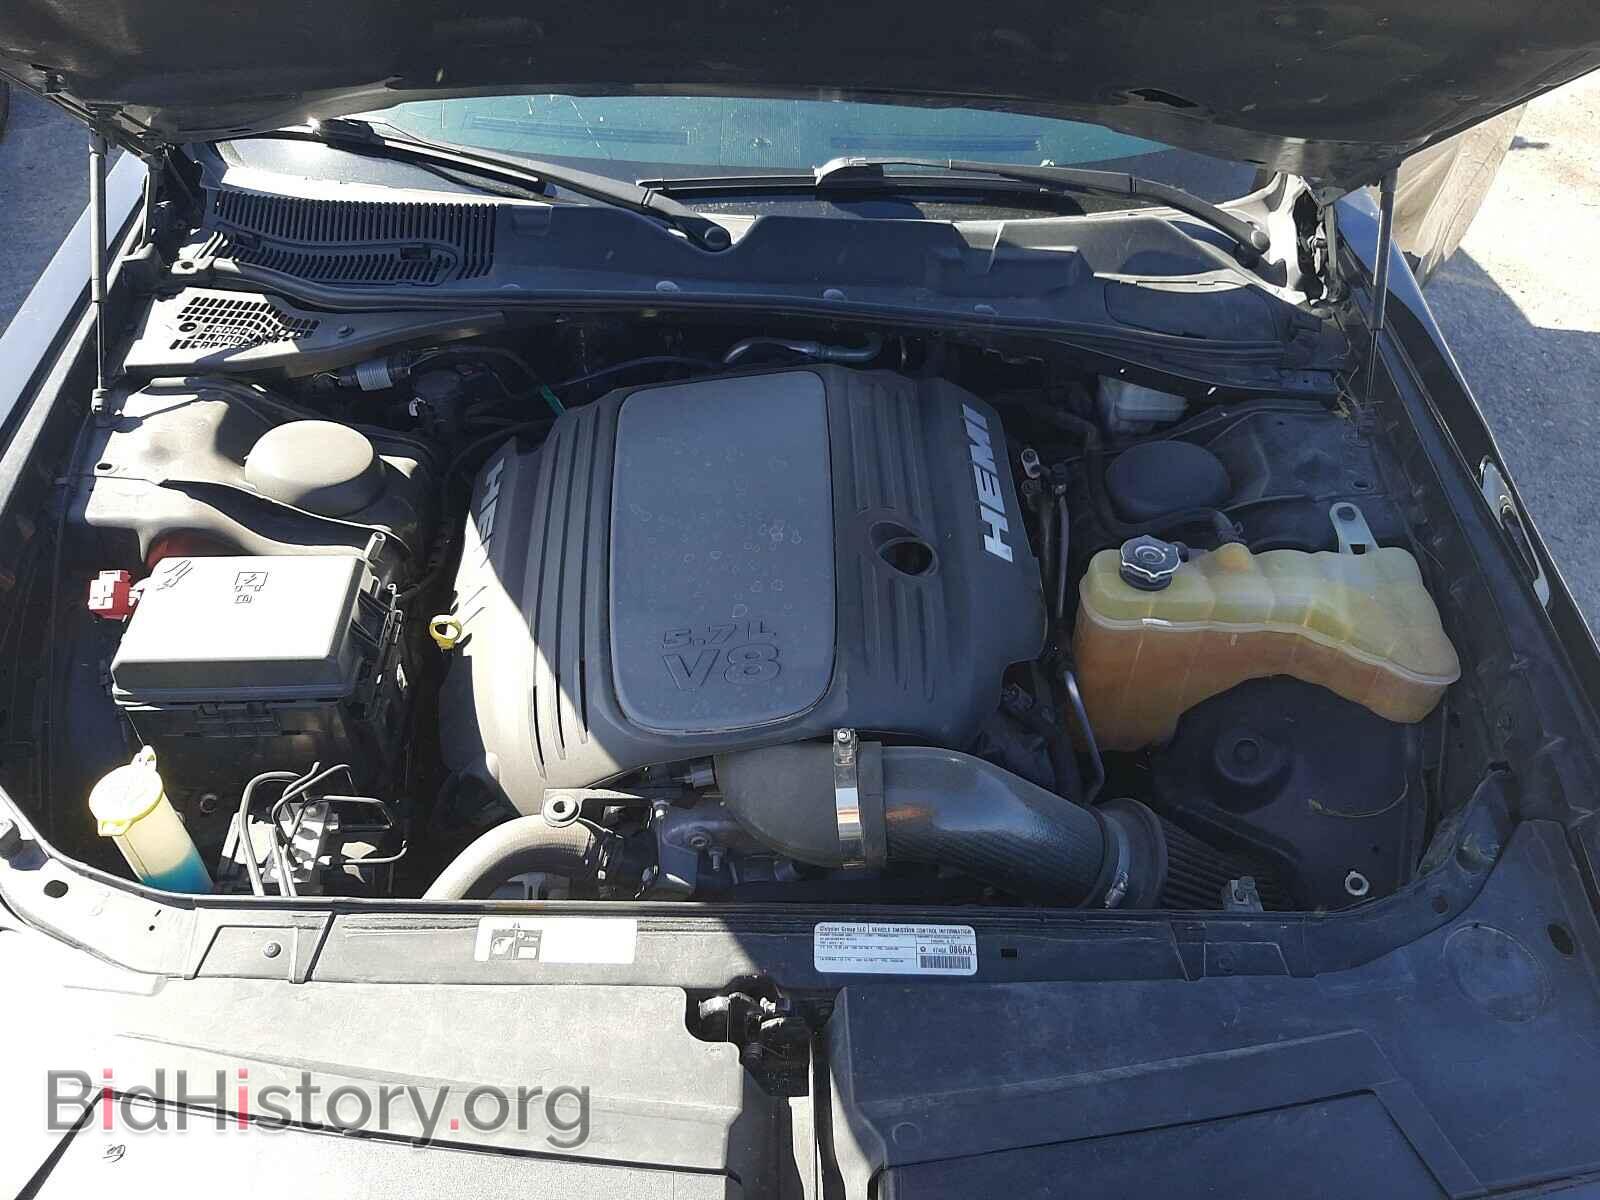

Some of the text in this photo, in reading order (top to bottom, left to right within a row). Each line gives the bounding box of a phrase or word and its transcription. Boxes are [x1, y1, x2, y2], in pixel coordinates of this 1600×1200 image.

[962, 403, 1014, 563] HEMI
[662, 619, 777, 649] 5.7L
[662, 643, 782, 691] V8
